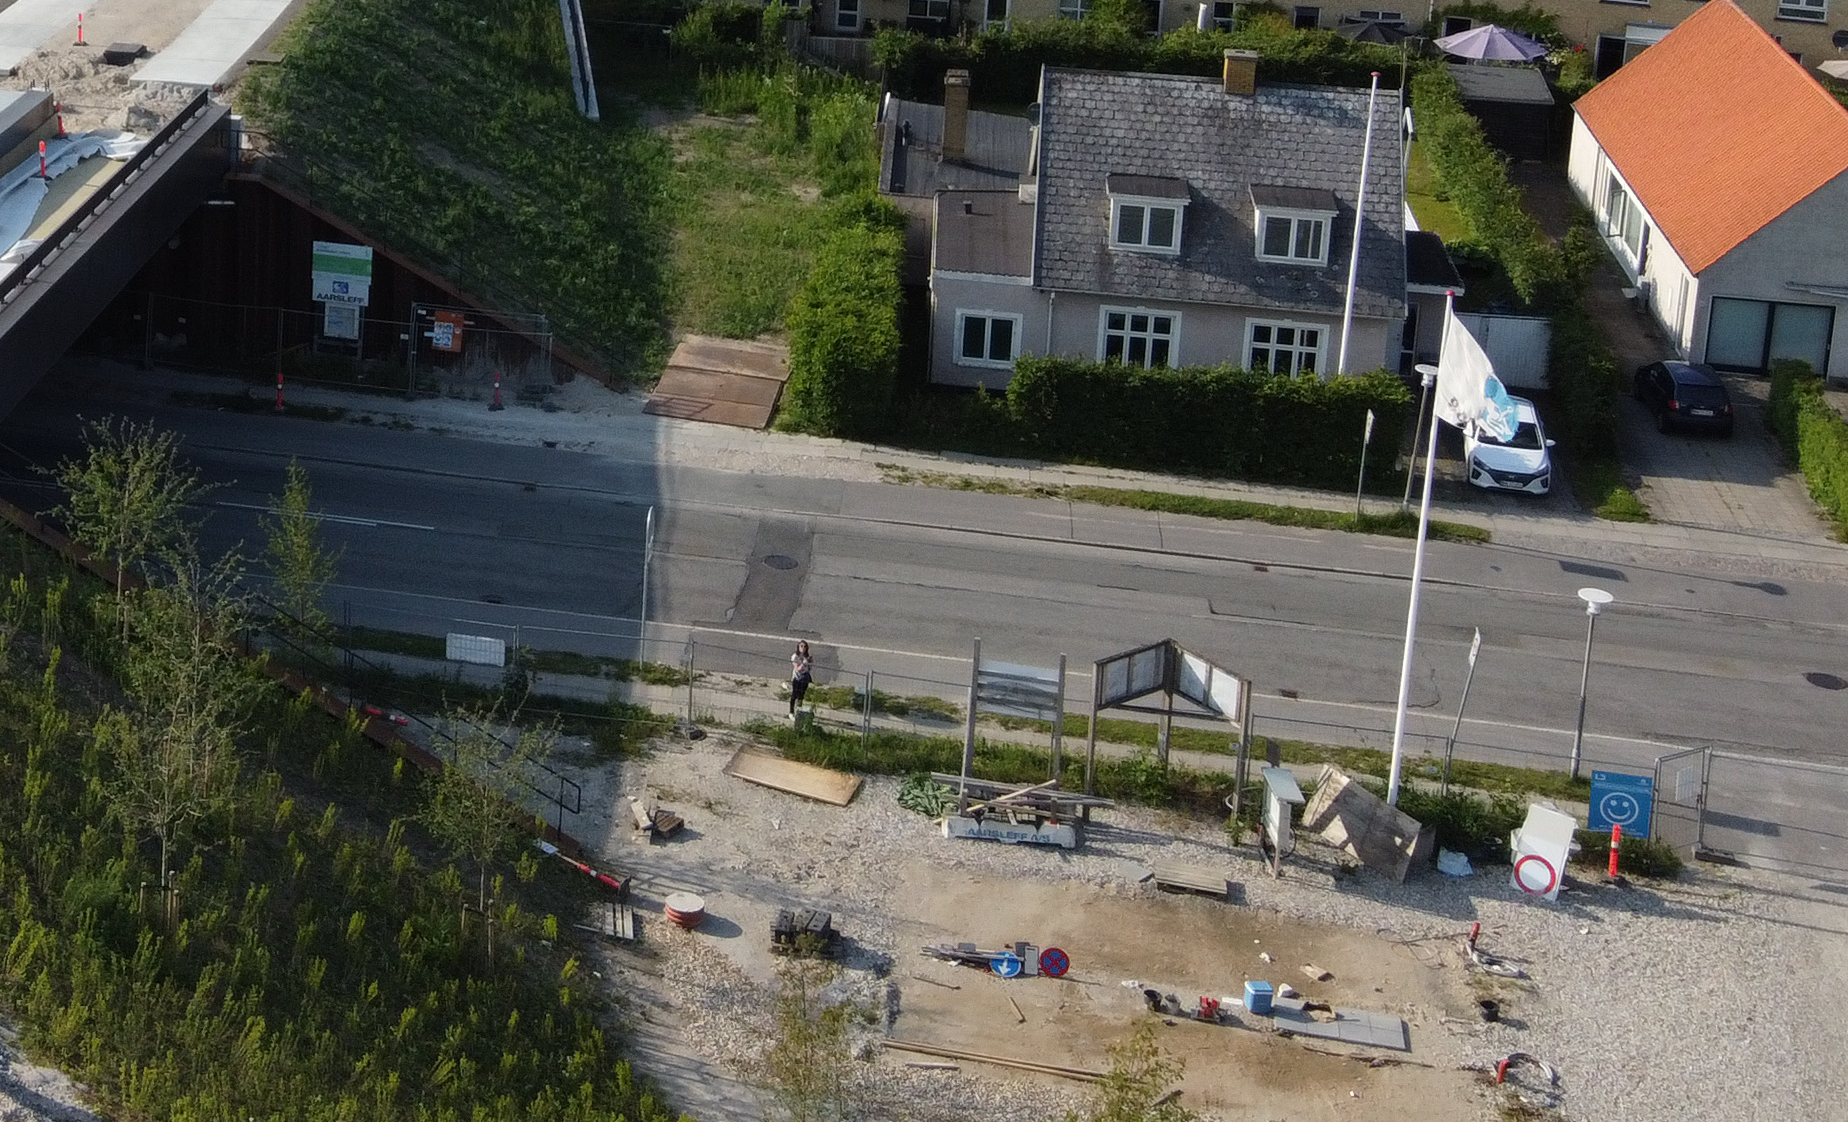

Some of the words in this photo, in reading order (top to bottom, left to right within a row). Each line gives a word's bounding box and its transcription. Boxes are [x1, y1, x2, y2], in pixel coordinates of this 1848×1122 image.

[316, 292, 365, 304] AARSLEFF
[968, 828, 1028, 840] AARSLEFF
[1031, 833, 1050, 843] A/S
